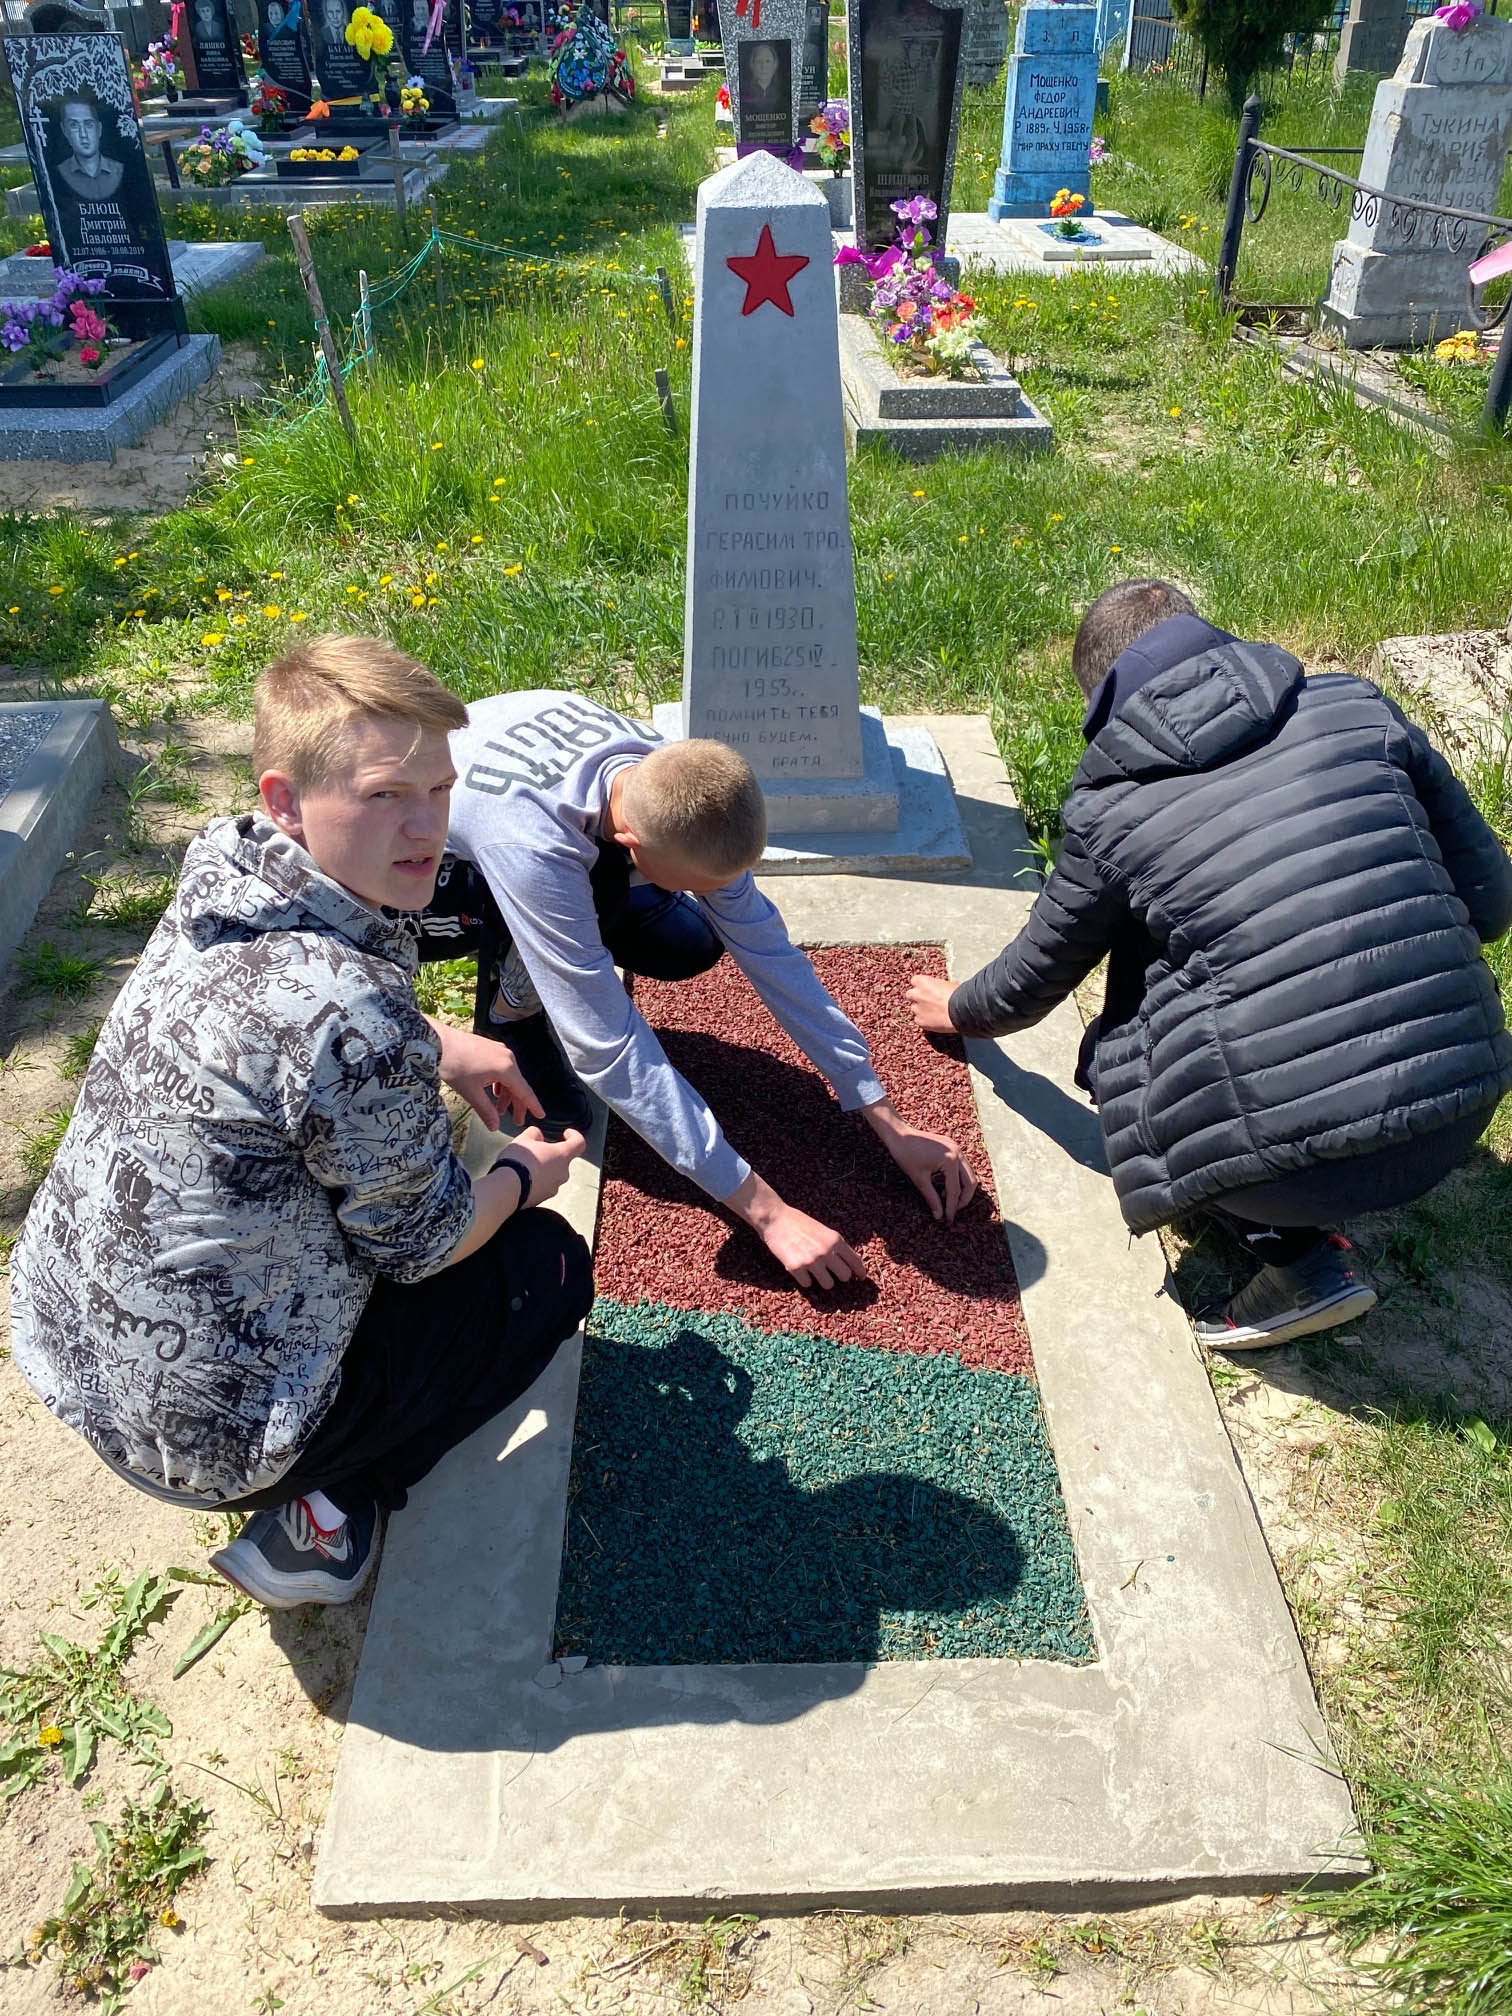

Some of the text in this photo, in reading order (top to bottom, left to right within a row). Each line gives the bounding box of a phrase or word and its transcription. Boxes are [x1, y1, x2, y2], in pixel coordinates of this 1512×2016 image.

[1035, 143, 1060, 152] ПРАХУ
[79, 203, 121, 216] БЛЮЩ
[80, 216, 127, 233] Дмитрий
[81, 230, 131, 245] Павлович
[725, 485, 830, 511] ПОЧУЙКО
[706, 531, 795, 551] ГЕРАСИМ
[796, 704, 839, 719] ТЕБЯ
